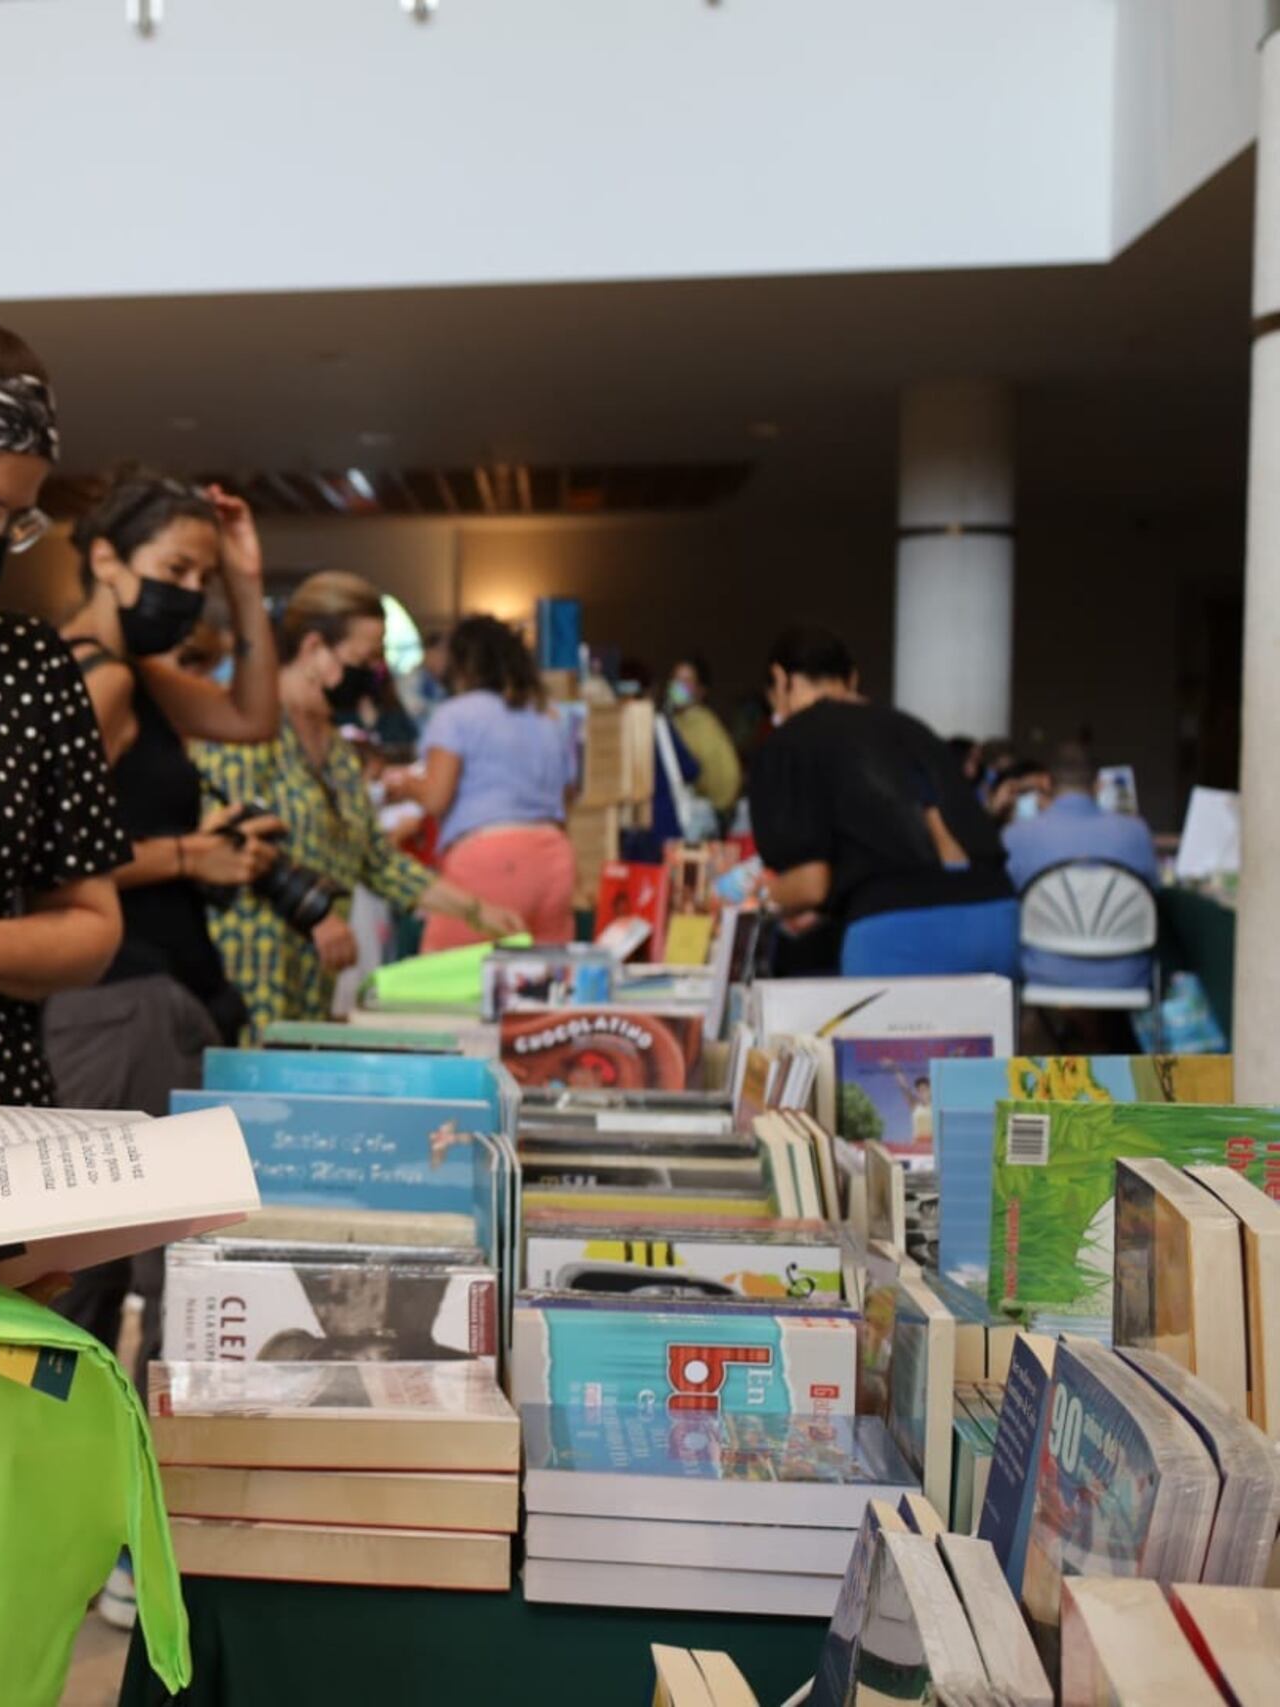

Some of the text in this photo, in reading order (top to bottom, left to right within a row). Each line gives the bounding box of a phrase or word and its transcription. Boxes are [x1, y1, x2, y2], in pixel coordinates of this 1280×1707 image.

[219, 1296, 247, 1362] CLE
[746, 1368, 772, 1405] En
[1050, 1381, 1083, 1474] 90
